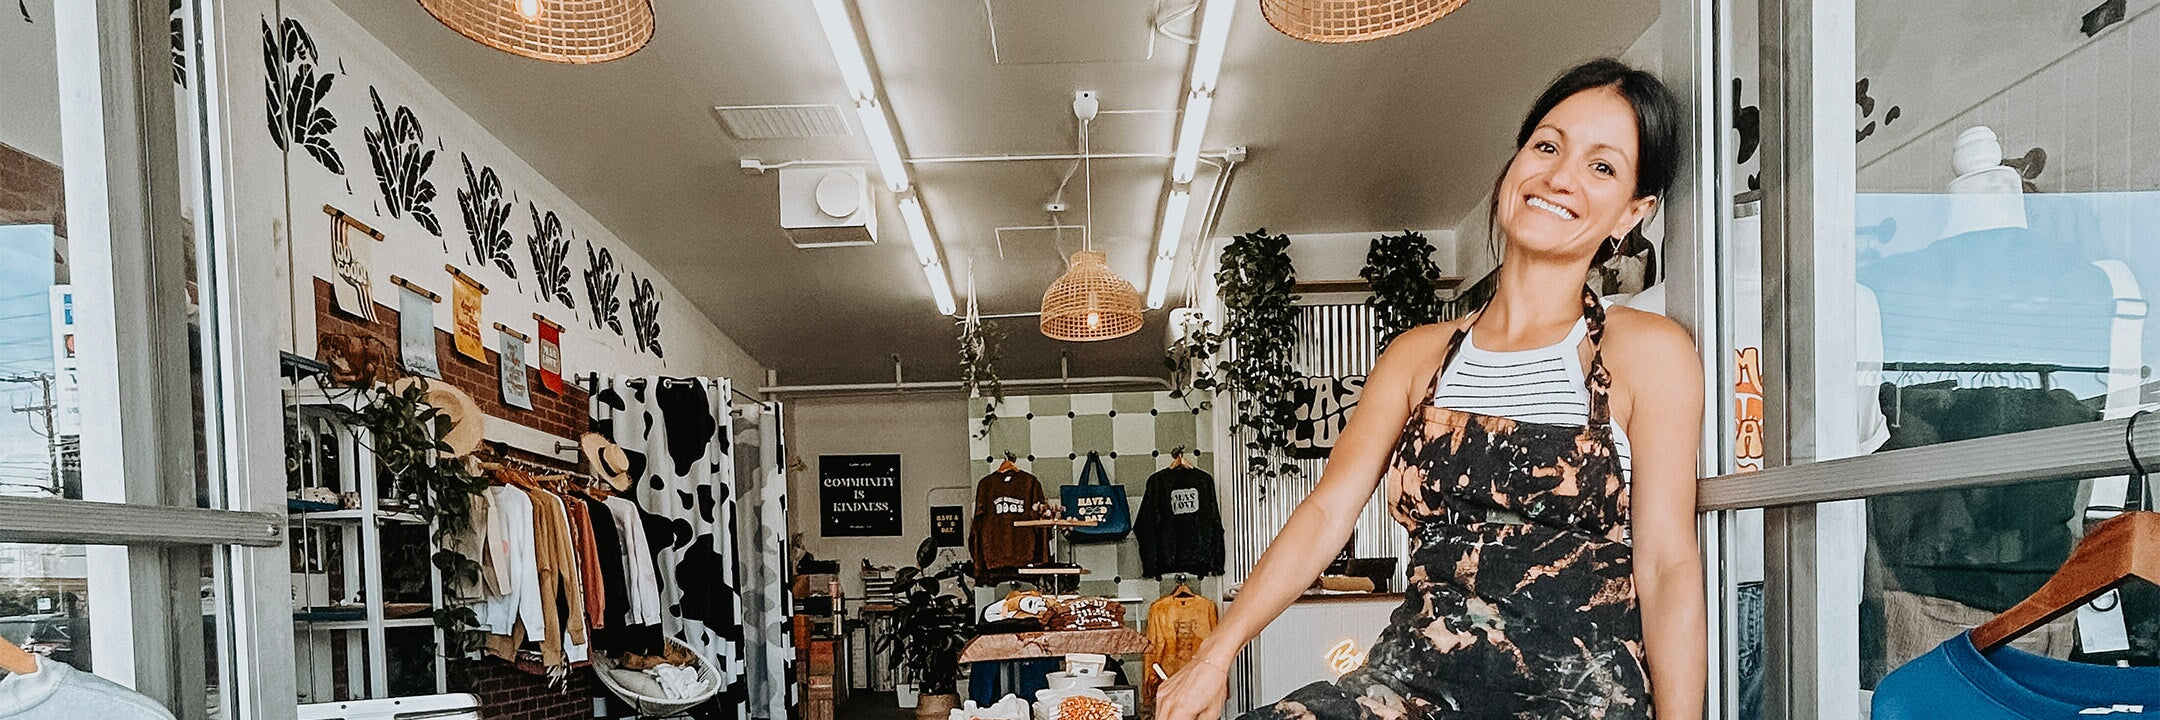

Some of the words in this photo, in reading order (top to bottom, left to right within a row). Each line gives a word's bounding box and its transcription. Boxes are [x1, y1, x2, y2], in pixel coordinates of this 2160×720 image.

[1286, 376, 1365, 421] CAS
[823, 476, 896, 488] COMMUNITY
[853, 489, 865, 500] IS
[833, 501, 889, 512] KINDNESS
[1077, 496, 1104, 507] HAVE
[1104, 496, 1113, 506] A
